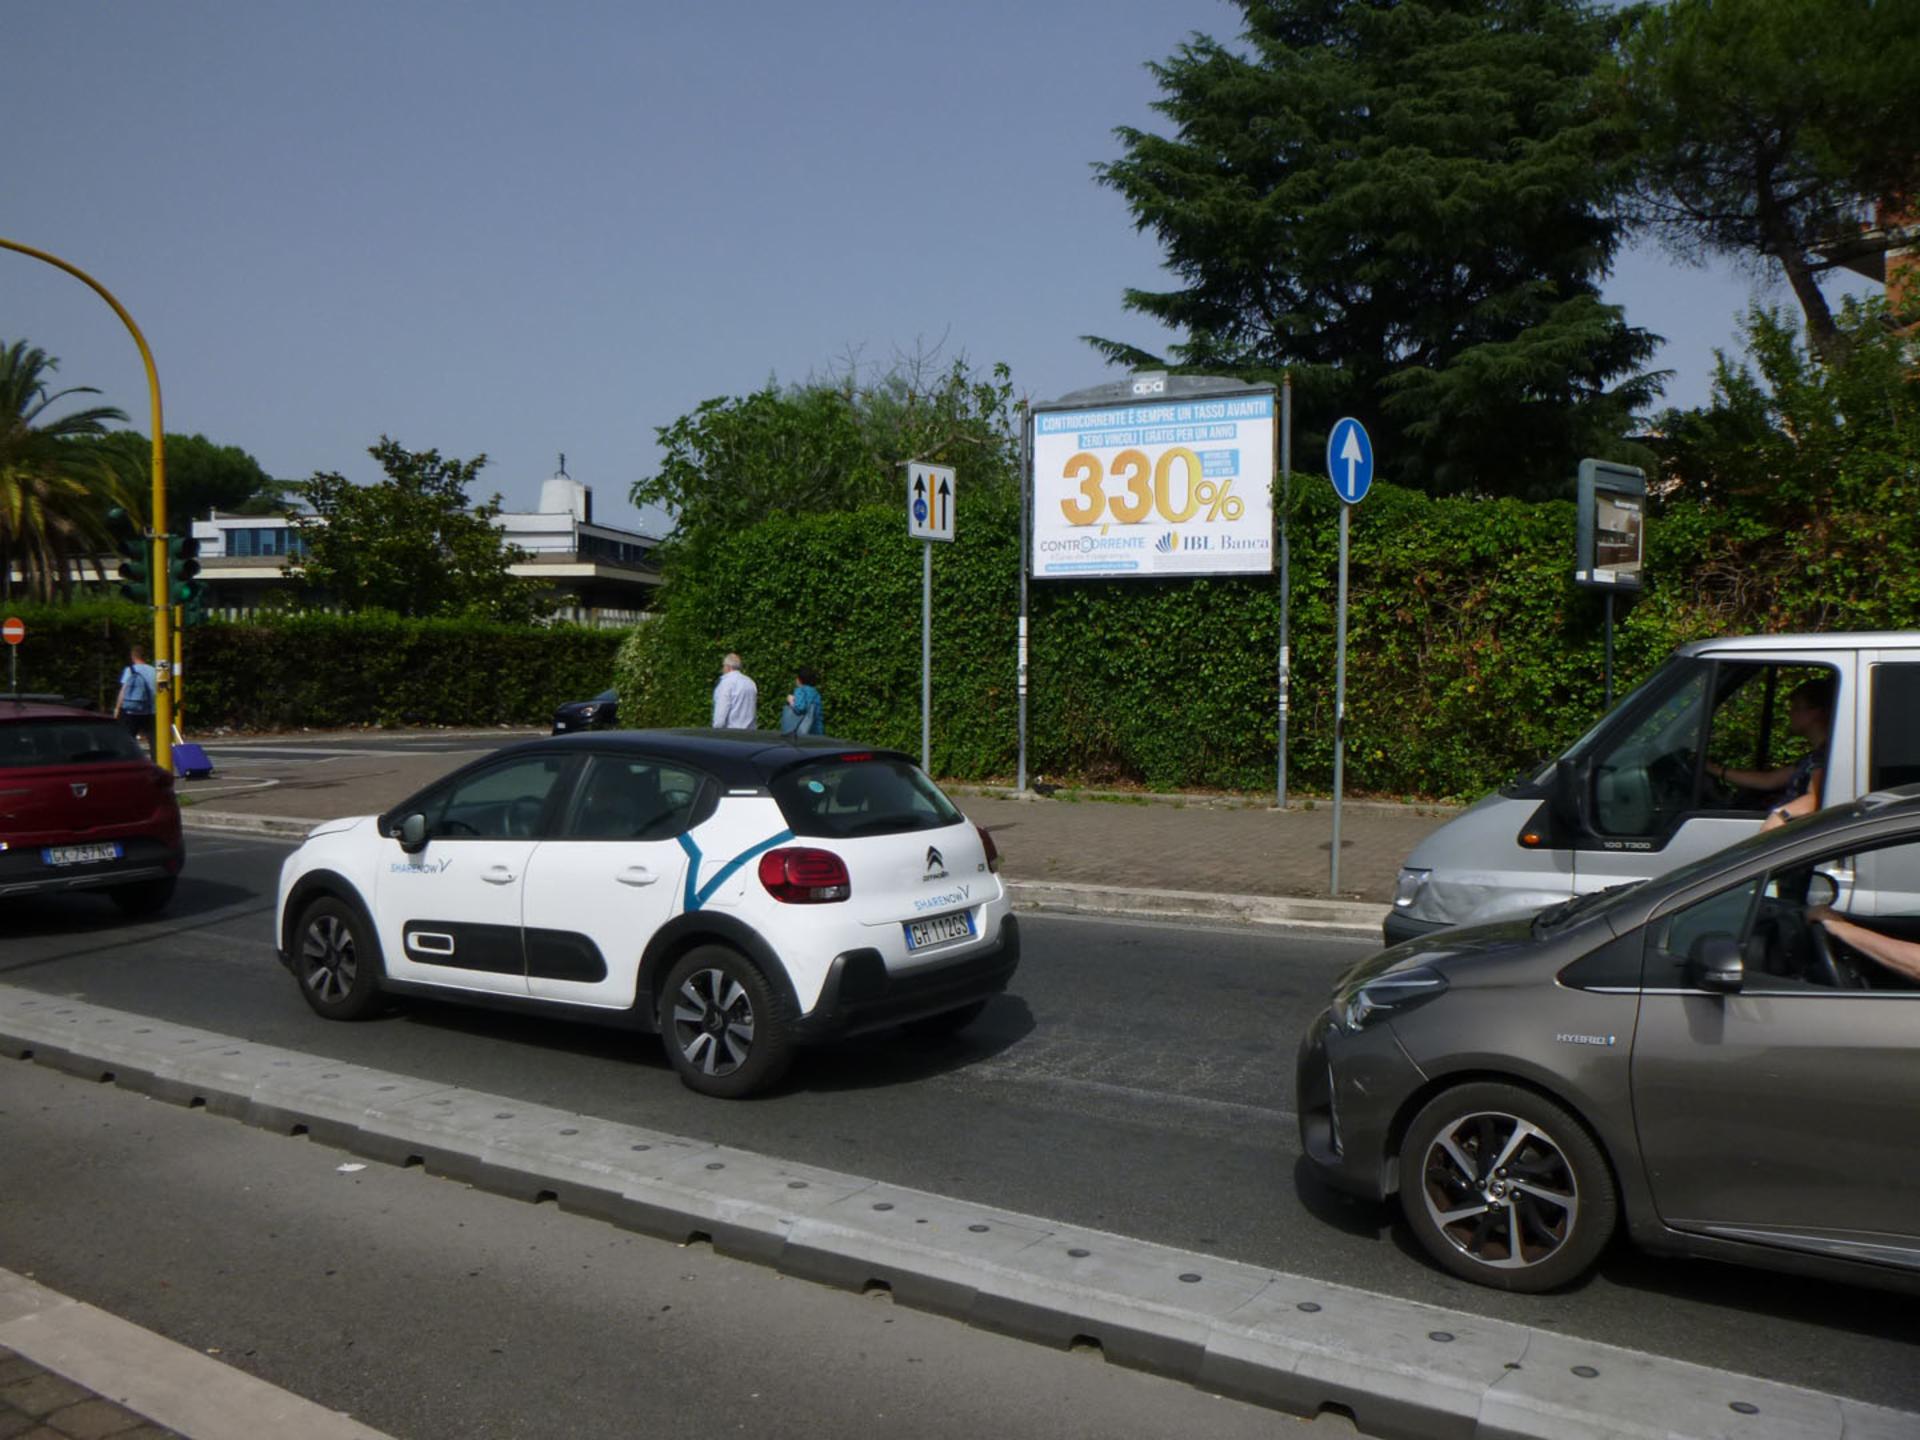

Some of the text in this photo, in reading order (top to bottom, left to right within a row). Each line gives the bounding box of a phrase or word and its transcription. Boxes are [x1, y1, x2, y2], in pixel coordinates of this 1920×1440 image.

[1043, 414, 1126, 431] CONTROCORRENTE
[1136, 407, 1175, 423] SEMPRE
[1178, 406, 1192, 418] UN
[1194, 404, 1225, 417] TASSO
[1081, 431, 1138, 447] ZERO VINCOLI
[1144, 423, 1234, 443] GRATIS PER UN ANNO
[1184, 535, 1269, 550] IBL Banca
[914, 893, 963, 911] SHARENOW
